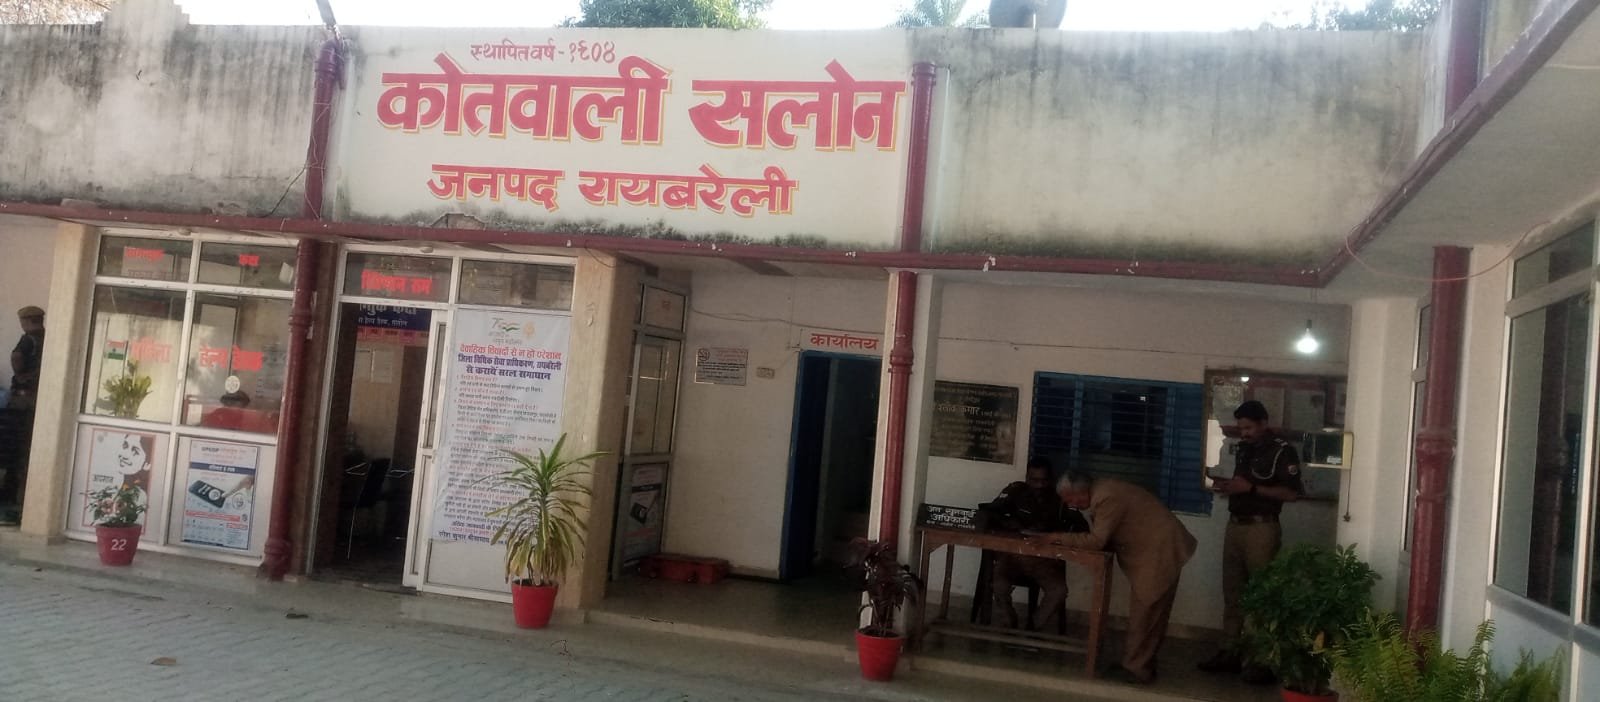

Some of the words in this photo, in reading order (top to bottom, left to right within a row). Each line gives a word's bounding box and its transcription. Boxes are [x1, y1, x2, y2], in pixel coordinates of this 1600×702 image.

[470, 38, 530, 61] स्थापित
[530, 37, 556, 61] वर्ष
[377, 52, 671, 143] कोतवाली
[688, 58, 906, 151] सलोन
[427, 164, 565, 211] जनपद
[578, 164, 799, 215] रायबरेली
[810, 333, 880, 350] कार्यालय
[111, 538, 127, 551] 22
